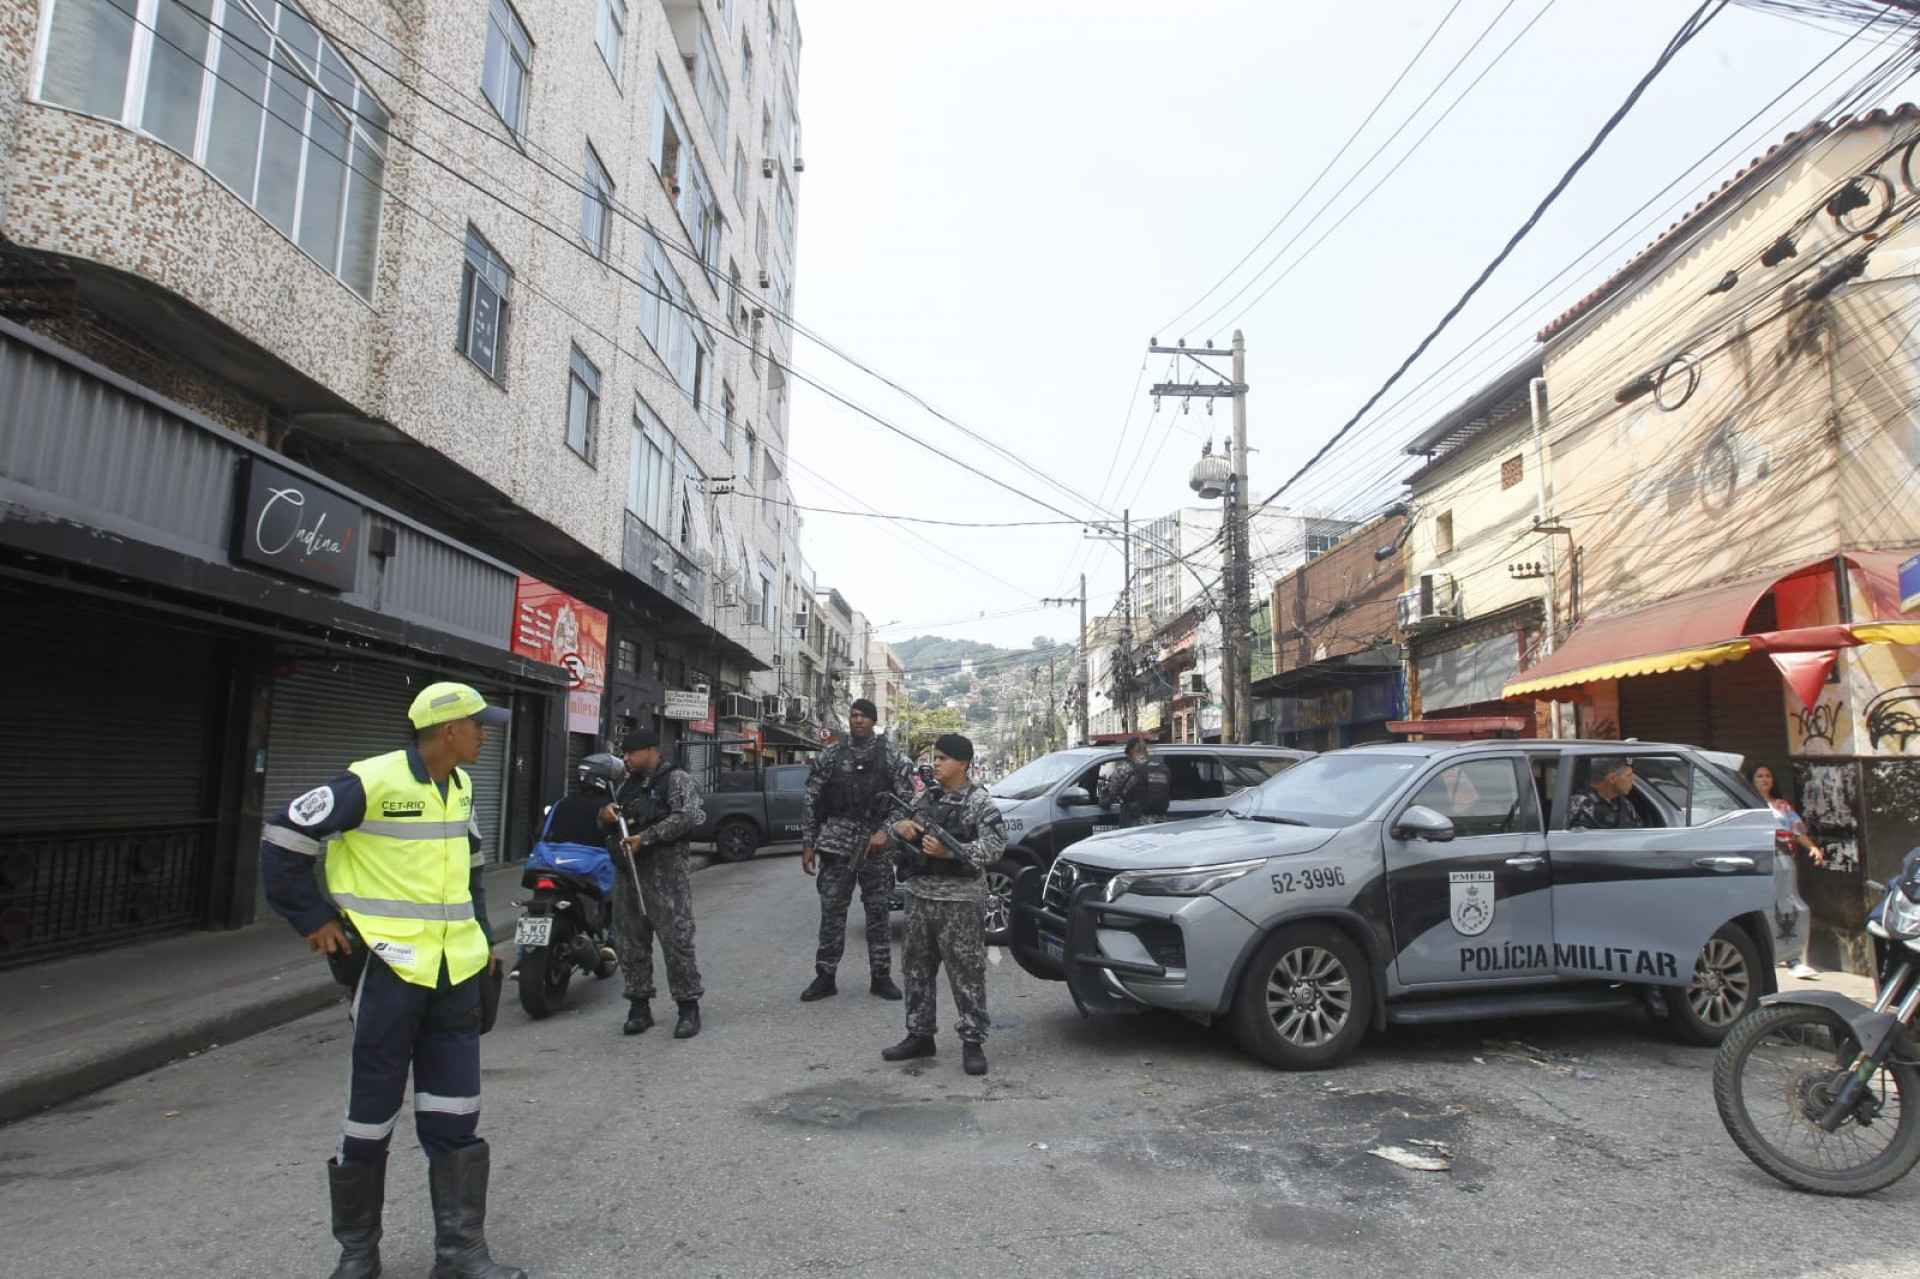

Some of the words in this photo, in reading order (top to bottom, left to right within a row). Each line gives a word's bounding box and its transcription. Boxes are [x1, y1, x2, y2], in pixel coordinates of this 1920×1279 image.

[382, 800, 426, 811] CET-RIO
[1271, 866, 1345, 894] 52-3996
[1460, 941, 1549, 972] POLÍCIA
[1553, 942, 1678, 978] MILITAR
